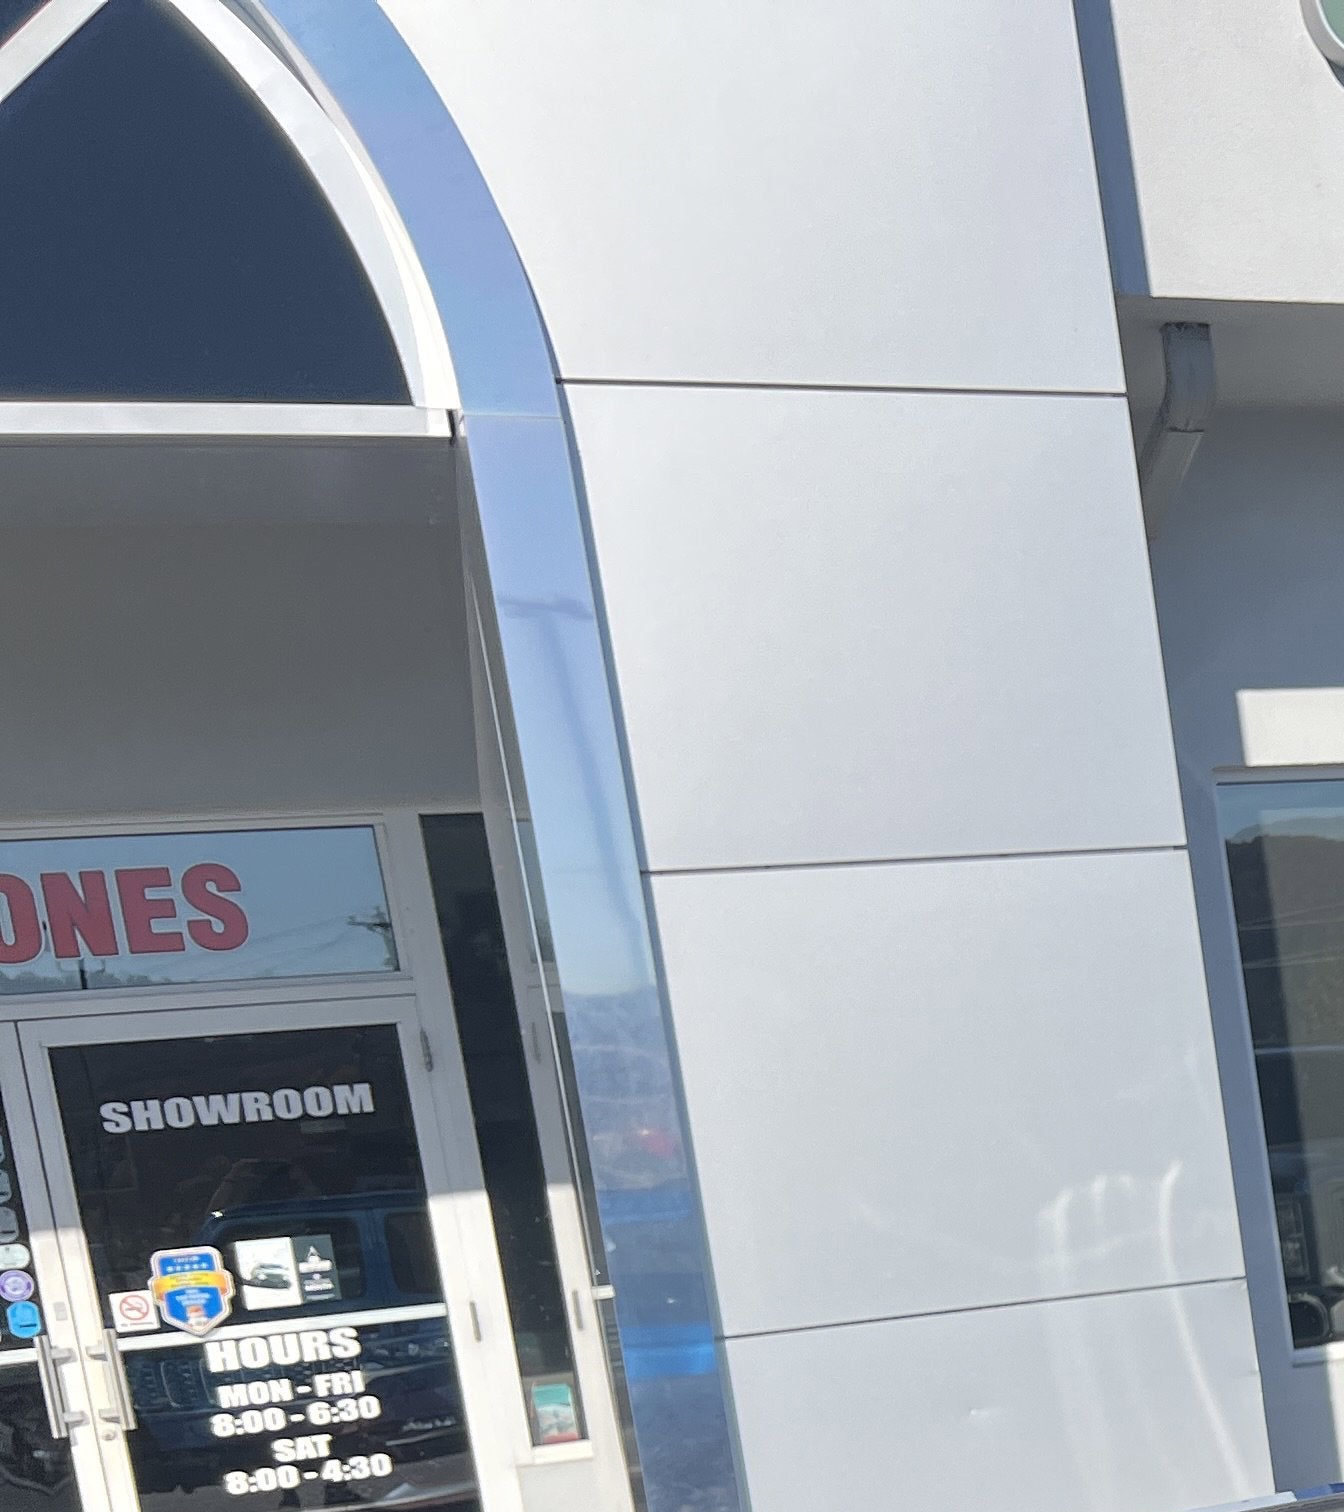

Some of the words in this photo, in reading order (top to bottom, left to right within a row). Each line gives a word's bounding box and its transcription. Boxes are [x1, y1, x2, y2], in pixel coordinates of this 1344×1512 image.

[100, 1083, 375, 1134] SHOWROOM
[205, 1326, 362, 1373] HOURS
[217, 1379, 295, 1409] MON
[314, 1370, 366, 1397] FRI
[210, 1407, 287, 1437] 8:00
[306, 1395, 382, 1425] 6:30
[271, 1433, 333, 1462] SAT
[224, 1465, 300, 1495] 8:00
[320, 1453, 394, 1482] 4:30
